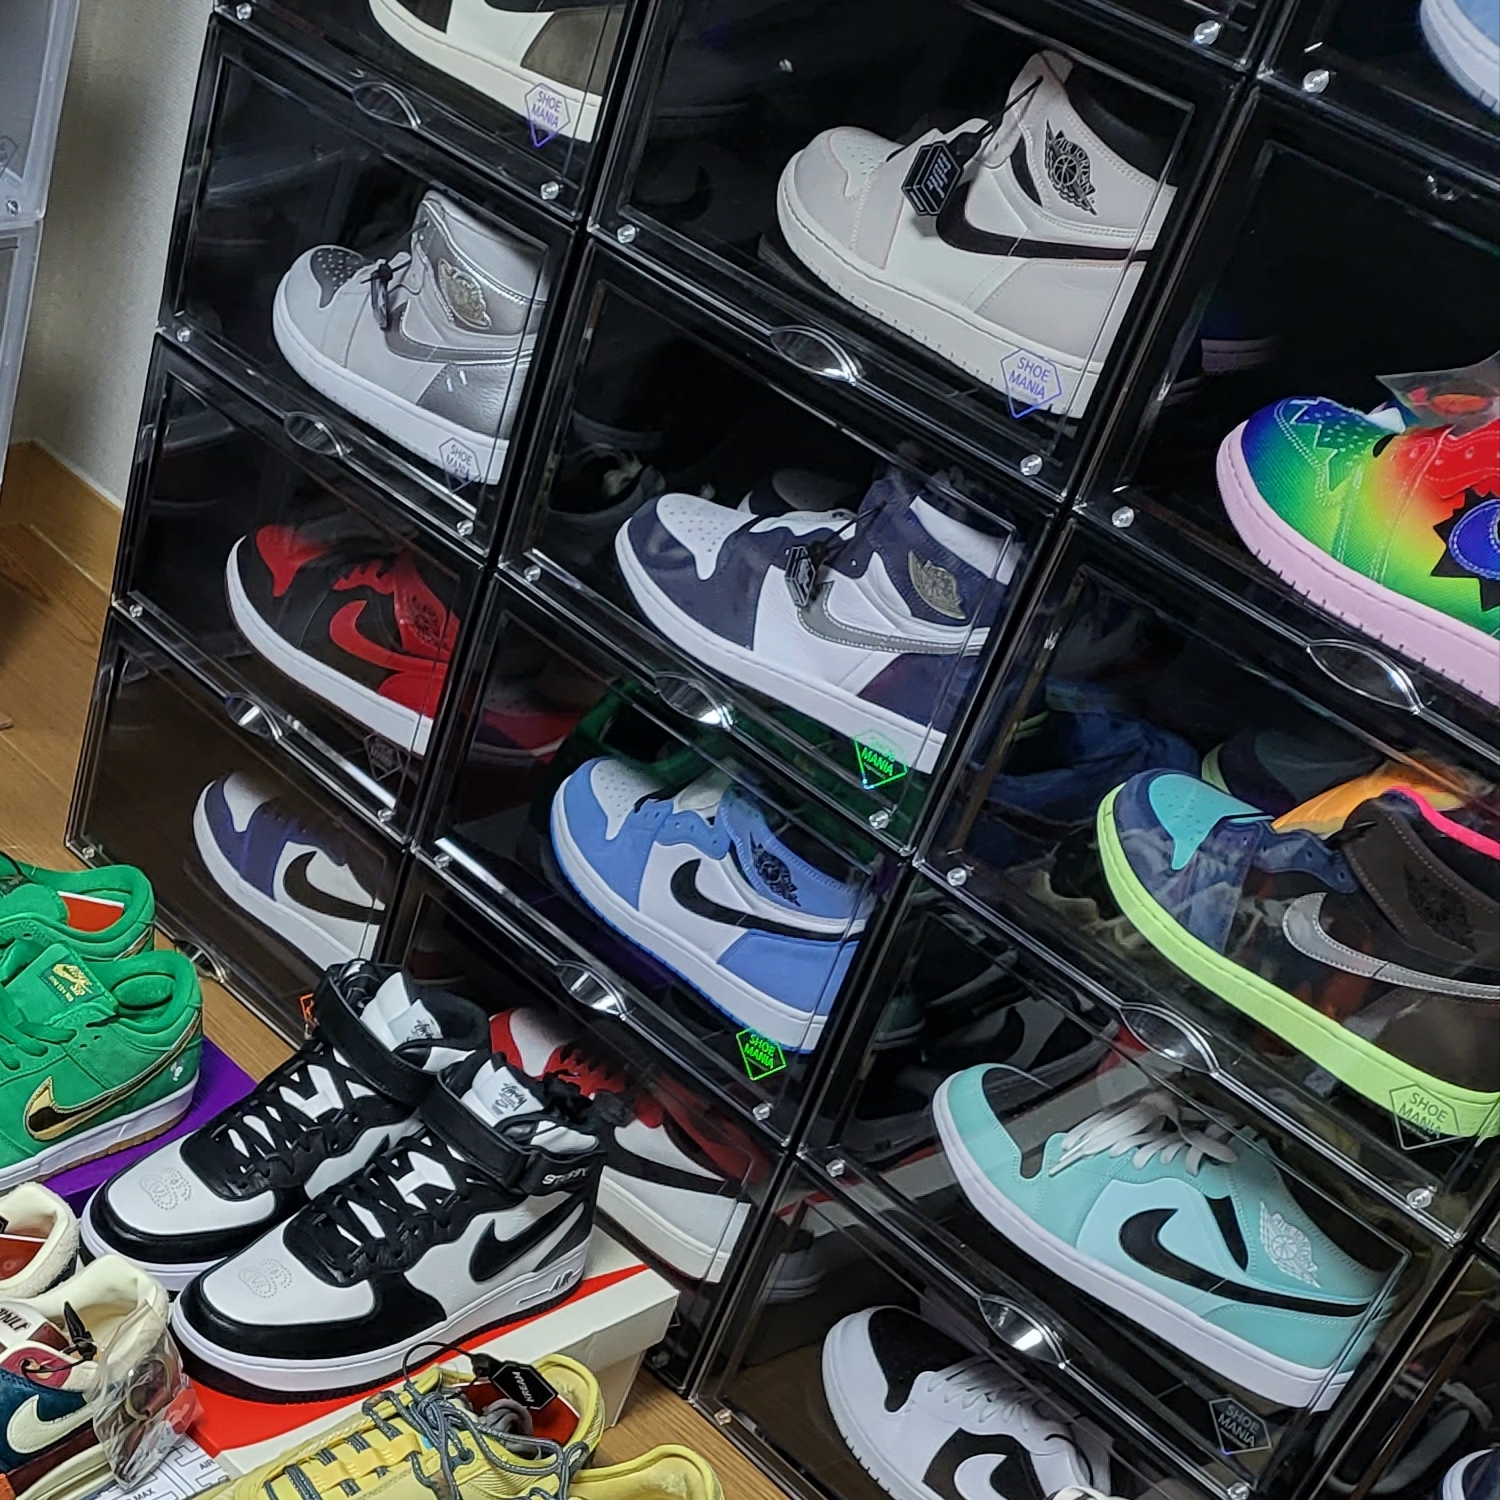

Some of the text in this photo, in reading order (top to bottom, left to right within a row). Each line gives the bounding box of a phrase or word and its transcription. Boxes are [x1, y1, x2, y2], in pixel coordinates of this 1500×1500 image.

[536, 90, 562, 113] SHOE
[531, 104, 559, 128] MANIA
[1017, 356, 1050, 381] SHOE
[1008, 371, 1047, 399] MANIA
[450, 444, 472, 466] SHOE
[861, 747, 894, 776] MANIA
[745, 1043, 775, 1069] MANIA
[749, 1034, 776, 1056] SHOE
[1399, 1103, 1442, 1138] MANIA
[1411, 1092, 1449, 1123] SHOE
[512, 1371, 535, 1402] KREAM
[1218, 1413, 1254, 1448] MANIA
[1226, 1405, 1260, 1433] SHOE
[200, 1458, 215, 1471] AIR
